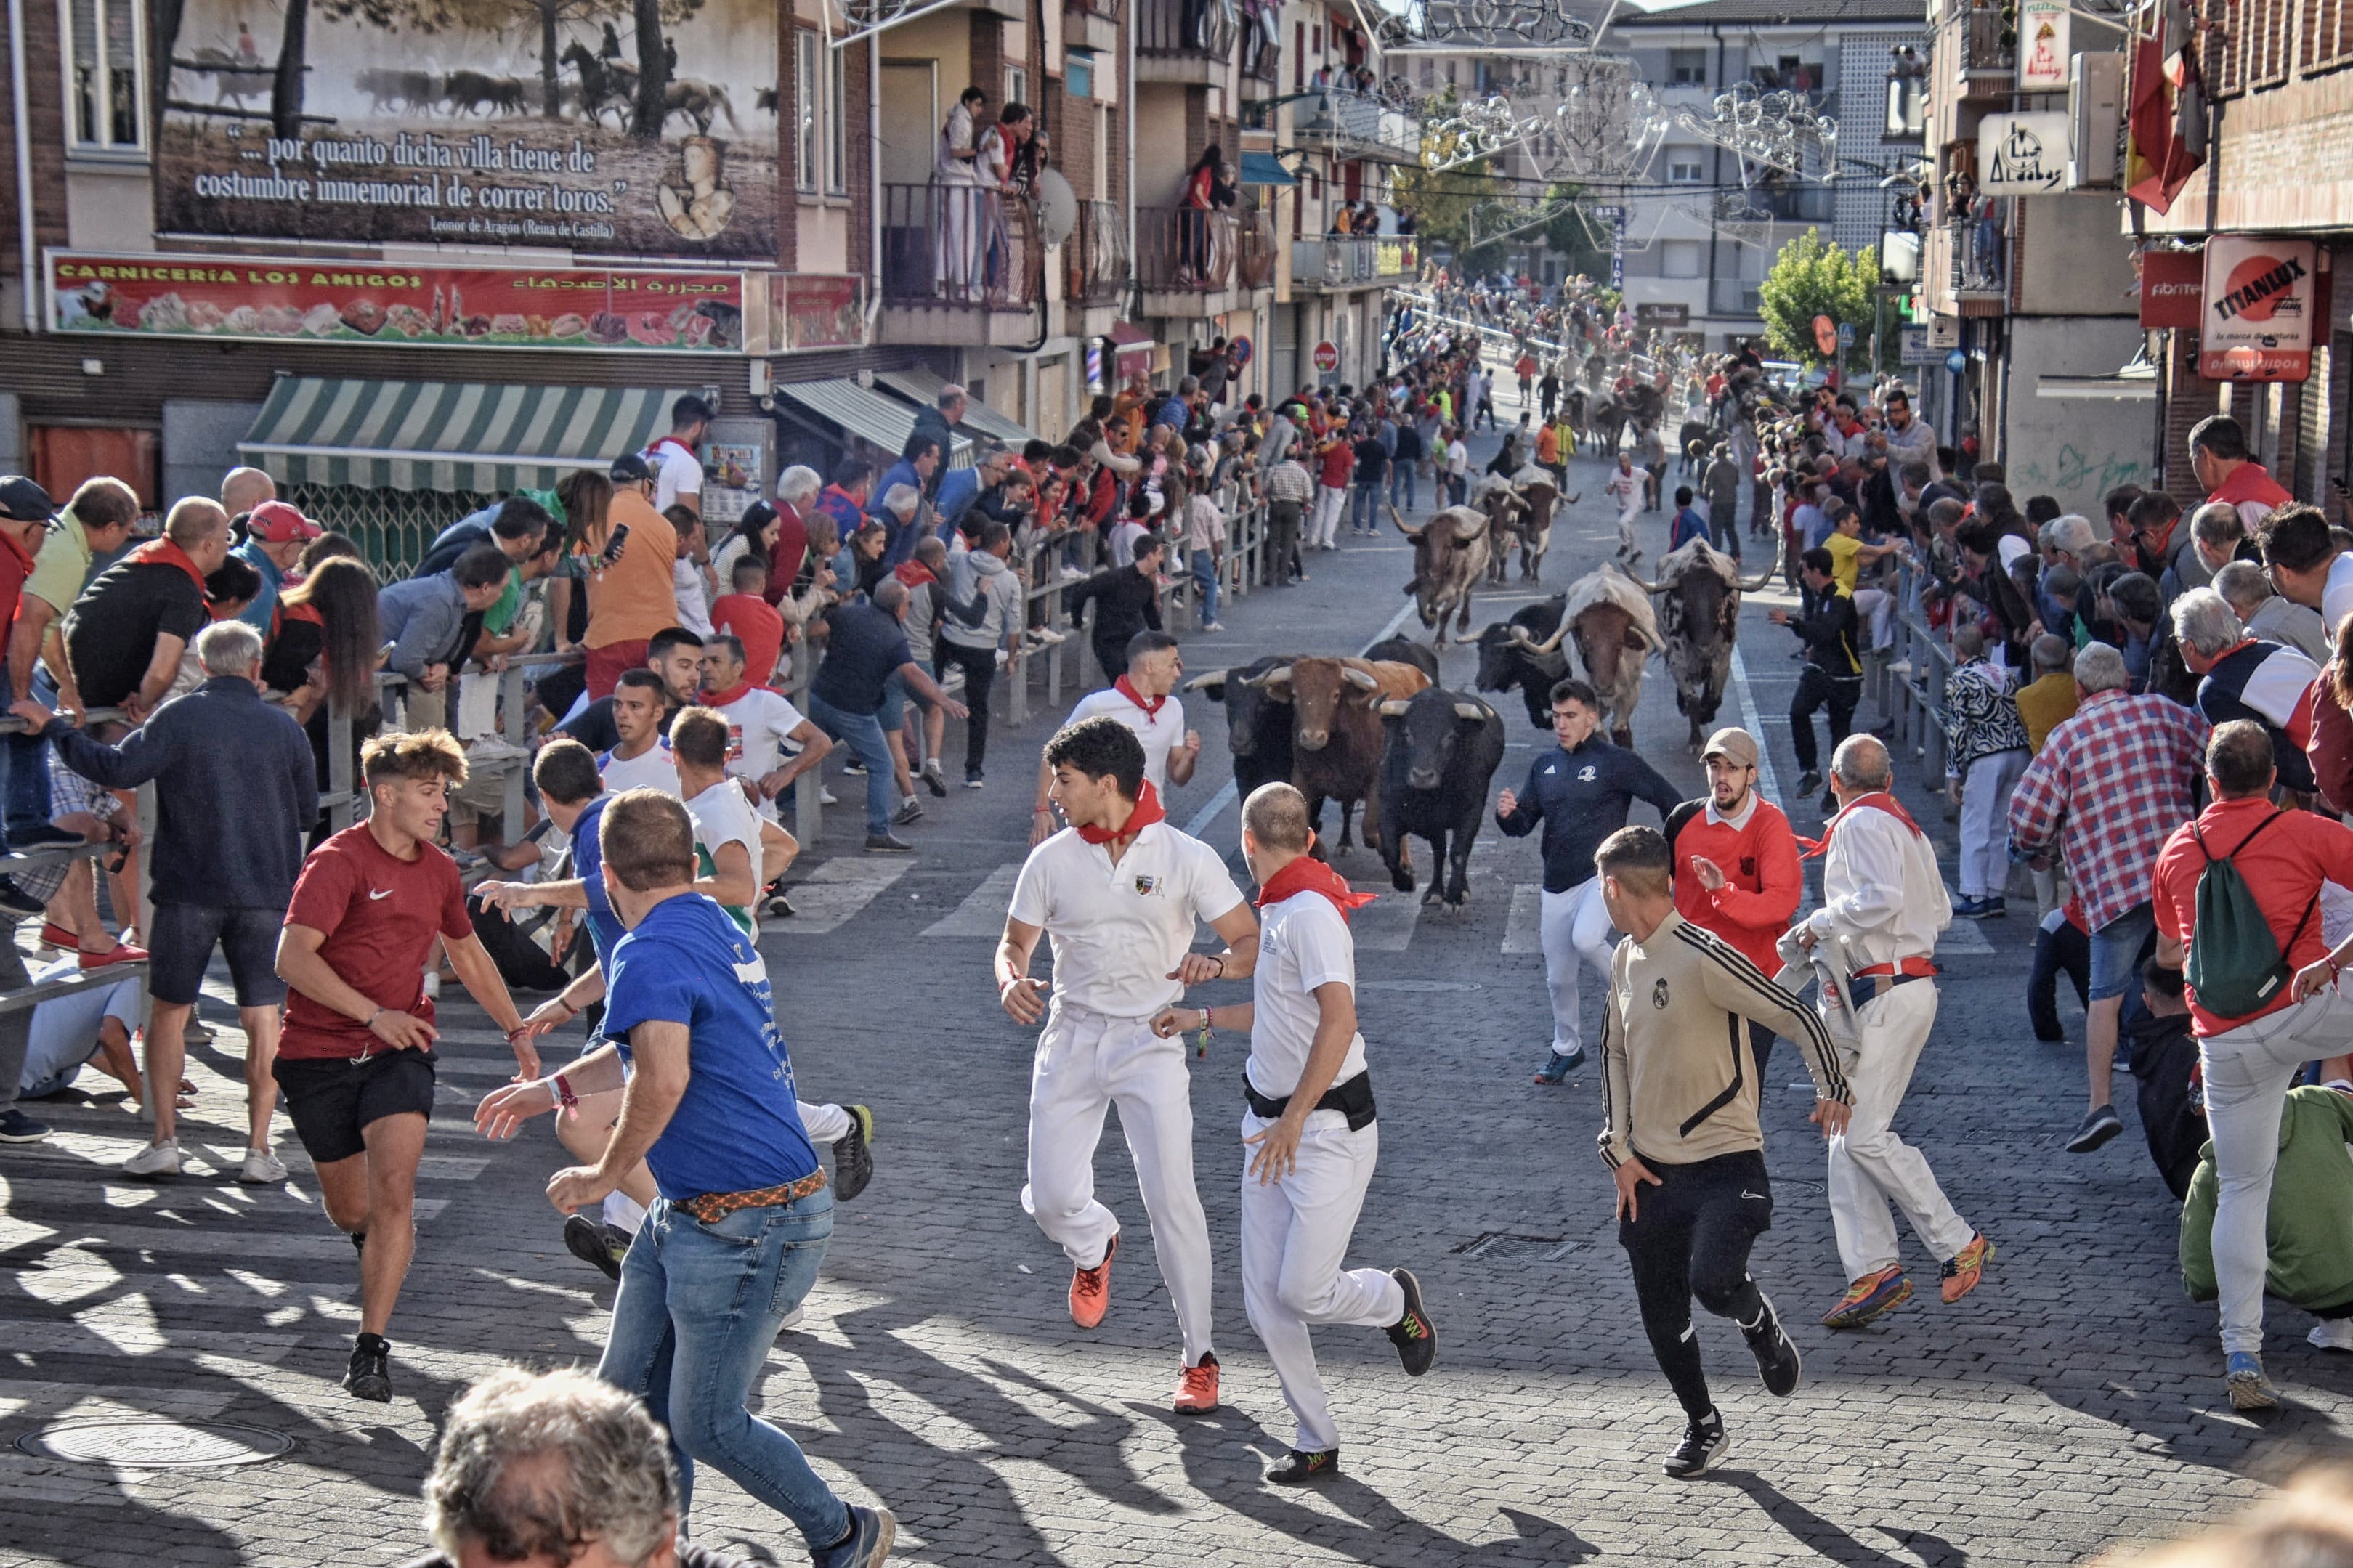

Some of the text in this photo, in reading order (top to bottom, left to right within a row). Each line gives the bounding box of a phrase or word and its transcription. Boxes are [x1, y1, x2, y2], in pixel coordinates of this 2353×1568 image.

[267, 137, 306, 165] por
[312, 137, 387, 168] quanto
[393, 132, 450, 168] dicha
[459, 135, 503, 168] villa
[510, 139, 562, 171] tiene
[568, 140, 594, 173] de
[195, 167, 309, 200] costumbre
[317, 171, 440, 206] inmemorial
[446, 175, 471, 207] de
[479, 186, 546, 211] correr
[430, 216, 615, 238] Leonor de Aragón (Reina de Castilla)
[248, 271, 299, 285] LOS
[311, 272, 421, 288] AMIGOS
[2214, 256, 2307, 321] TITANLUX
